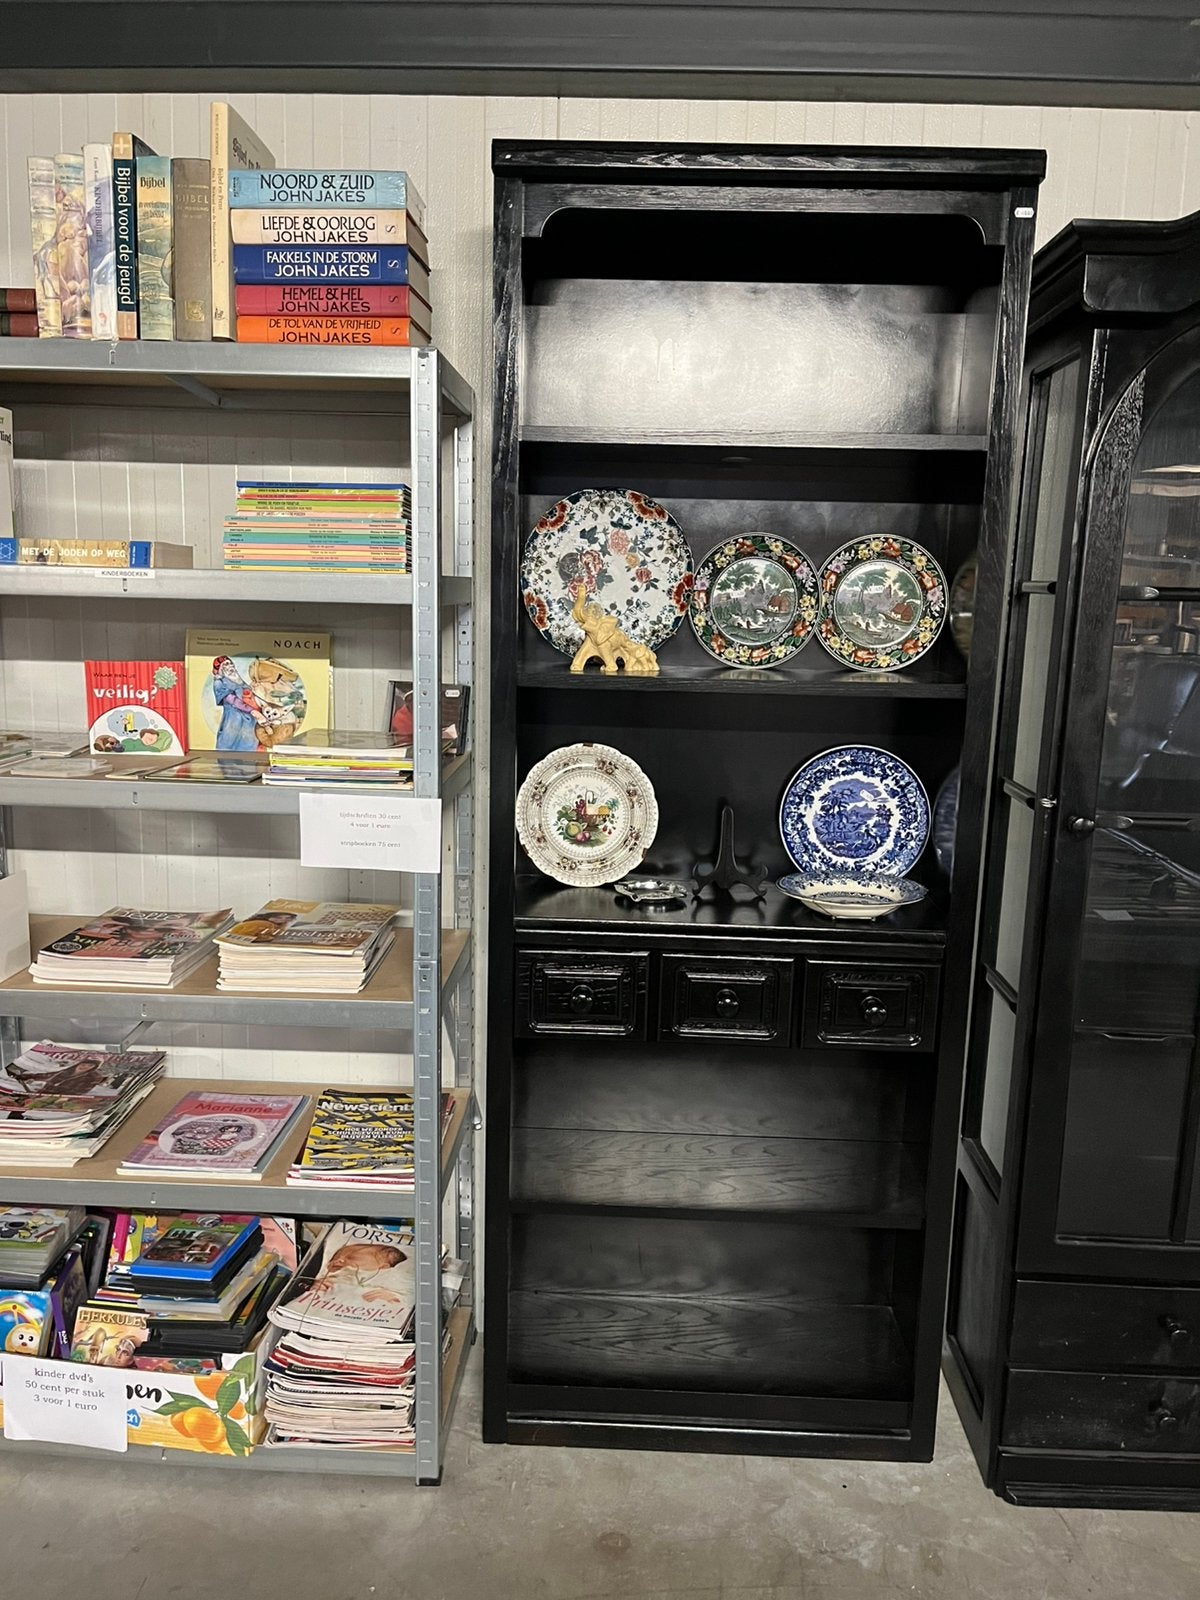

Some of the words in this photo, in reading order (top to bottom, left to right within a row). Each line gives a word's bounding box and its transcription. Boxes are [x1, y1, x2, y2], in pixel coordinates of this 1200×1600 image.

[117, 167, 132, 206] Bijbel
[140, 177, 166, 190] Bijbel
[260, 174, 318, 190] NOORD
[321, 174, 336, 189] &
[339, 175, 375, 190] ZUID
[269, 190, 313, 203] JOHN
[316, 191, 366, 203] JAKES
[118, 209, 131, 241] voor
[262, 215, 299, 231] LIEFDE
[303, 215, 316, 231] &
[317, 215, 376, 231] OORLOG
[273, 230, 317, 243] JOHN
[319, 231, 369, 243] JAKES
[118, 245, 132, 263] de
[266, 250, 311, 264] FAKKELS
[312, 251, 322, 264] IN
[326, 251, 339, 264] DE
[341, 251, 377, 265] STORM
[274, 264, 318, 277] JOHN
[320, 265, 370, 277] JAKES
[117, 265, 134, 305] jeugd
[282, 287, 324, 301] HEMEL
[325, 288, 339, 301] &
[340, 288, 364, 301] HEL
[277, 301, 320, 313] JOHN
[323, 301, 371, 313] JAKES
[268, 318, 281, 328] DE
[282, 318, 301, 328] TOL
[302, 318, 322, 329] VAN
[325, 318, 338, 329] DE
[339, 319, 381, 331] VRIJHEID
[278, 331, 321, 343] JOHN
[324, 332, 372, 344] JAKES
[21, 547, 40, 557] MET
[43, 547, 55, 557] DE
[59, 548, 88, 558] JODEN
[91, 548, 104, 559] OP
[106, 549, 126, 560] WEG
[101, 570, 148, 578] KINDERBOEKEN
[273, 639, 322, 650] NOACH
[93, 684, 158, 704] veilig?
[387, 813, 401, 821] cent
[195, 1102, 273, 1114] Marianne
[299, 1291, 404, 1320] Prinsesje!
[79, 1310, 147, 1329] HERKULES
[34, 1367, 65, 1379] kinder
[69, 1372, 94, 1384] dvd's
[25, 1380, 38, 1389] 50
[40, 1382, 61, 1392] cent
[64, 1386, 79, 1396] per
[82, 1387, 105, 1399] stuk
[33, 1394, 40, 1403] 3
[42, 1397, 64, 1407] voor
[74, 1402, 98, 1412] euro
